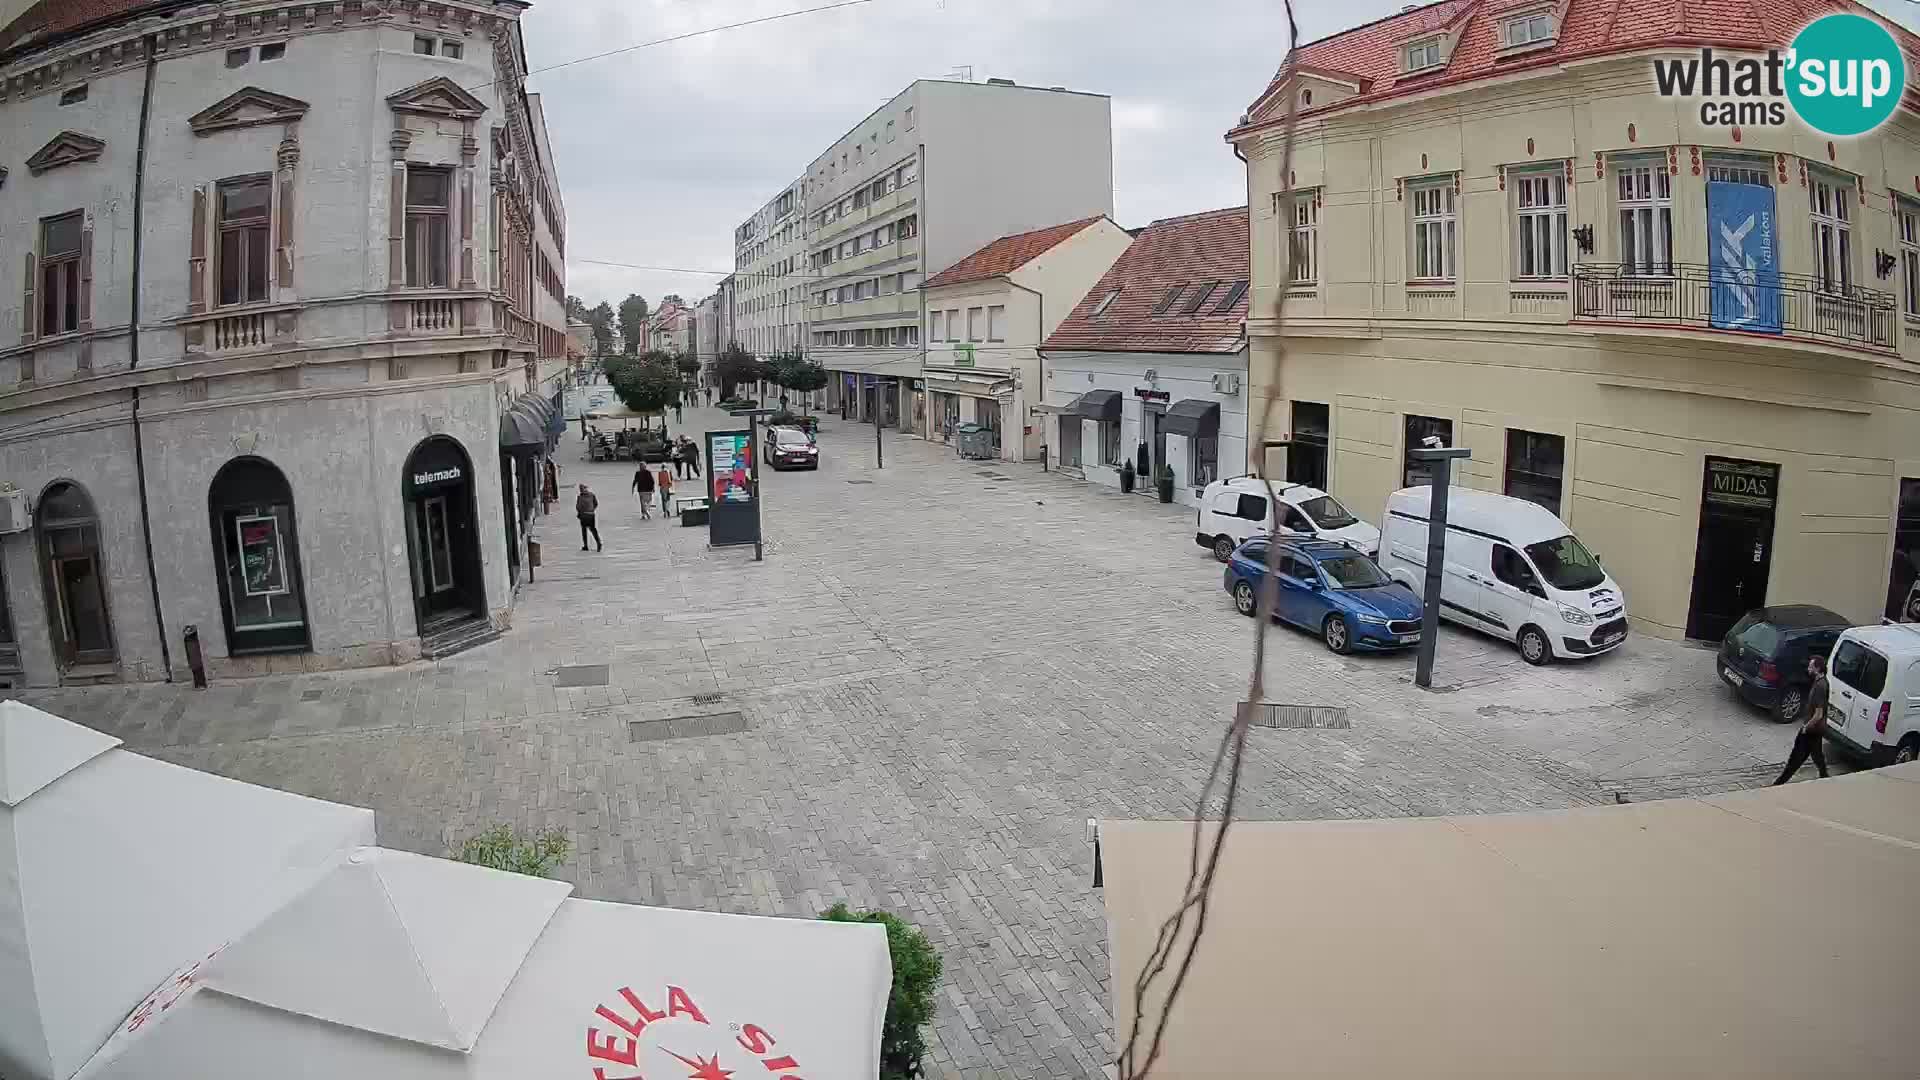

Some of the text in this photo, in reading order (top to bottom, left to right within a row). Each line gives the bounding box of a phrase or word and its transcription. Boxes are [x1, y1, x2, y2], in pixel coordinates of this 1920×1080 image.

[1759, 211, 1773, 267] valakon
[414, 467, 461, 485] telemach
[1713, 473, 1768, 495] MIDAS
